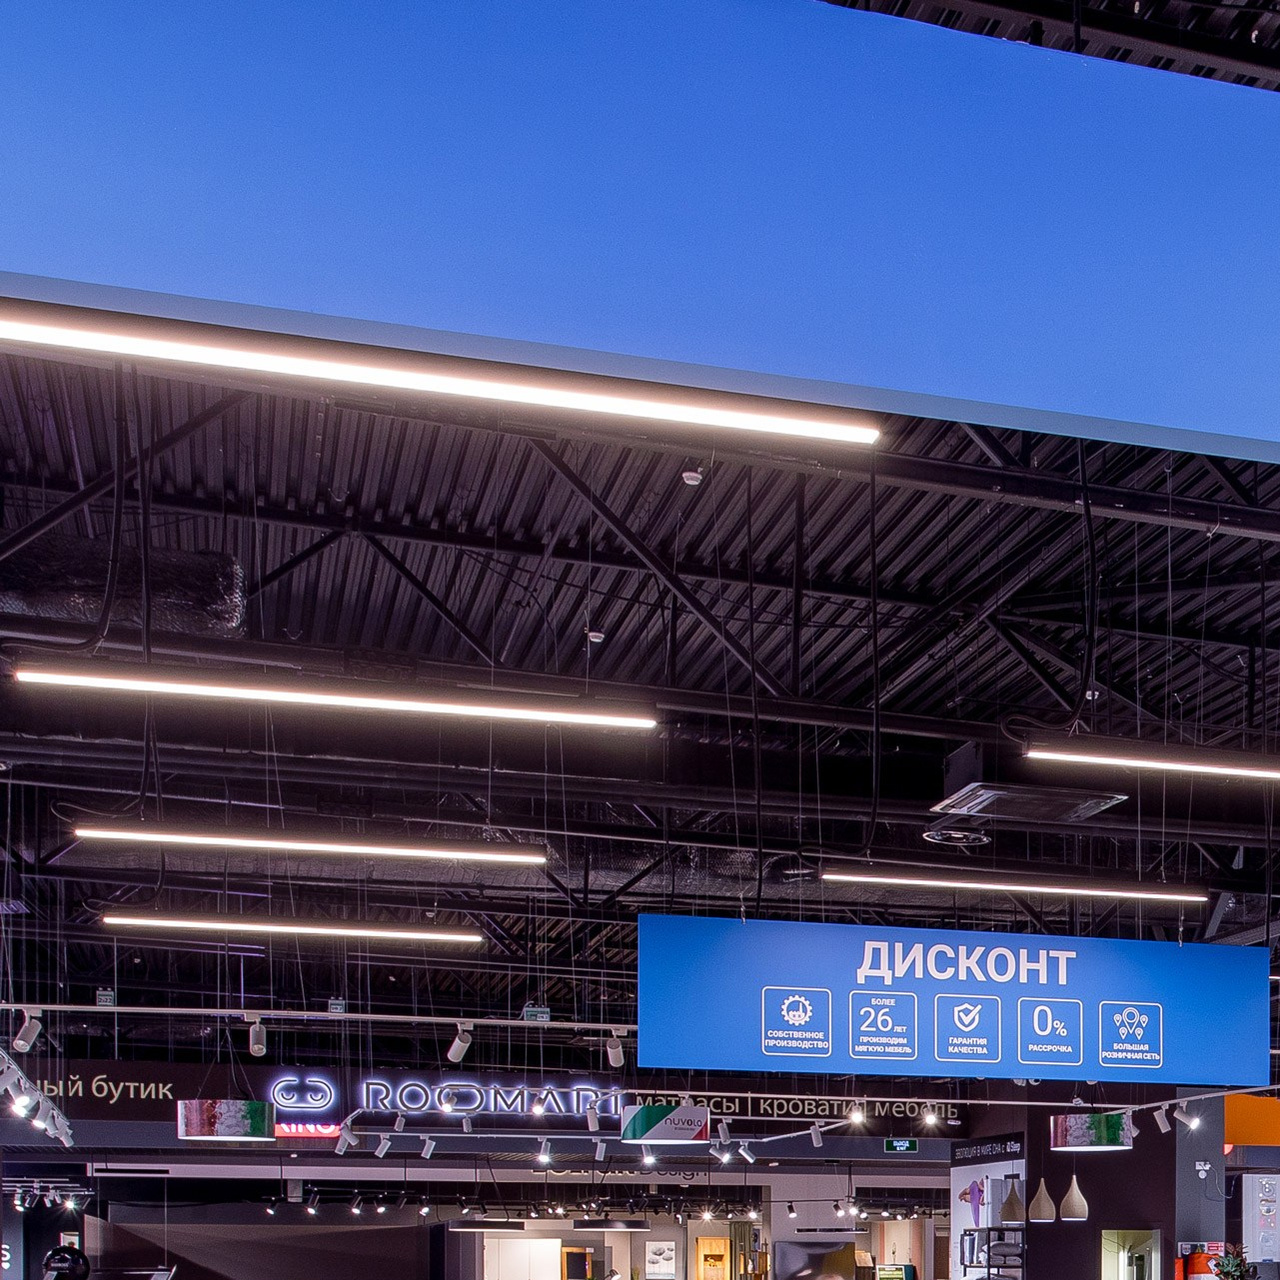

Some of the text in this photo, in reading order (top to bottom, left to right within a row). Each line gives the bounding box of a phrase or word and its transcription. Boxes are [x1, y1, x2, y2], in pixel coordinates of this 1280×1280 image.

[856, 940, 1077, 986] ДИСКОНТ
[871, 998, 896, 1006] БОЛЕЕ
[859, 1007, 907, 1033] 26 ЛЕТ
[767, 1030, 825, 1039] СОБСТВЕННОЕ
[764, 1039, 829, 1049] ПРОИЗВОДСТВО
[859, 1036, 908, 1044] ПРОИЗВОДИМ
[948, 1037, 988, 1046] ГАРАНТИЯ
[854, 1044, 912, 1054] МЯГКУЮ МЕБЕЛЬ
[948, 1046, 988, 1055] КАЧЕСТВА
[1028, 1044, 1073, 1053] РАССРОЧКА
[1113, 1043, 1149, 1051] БОЛЬШАЯ
[1102, 1051, 1160, 1060] РОЗНИЧНАЯ СЕТЬ
[92, 1075, 173, 1104] бутик
